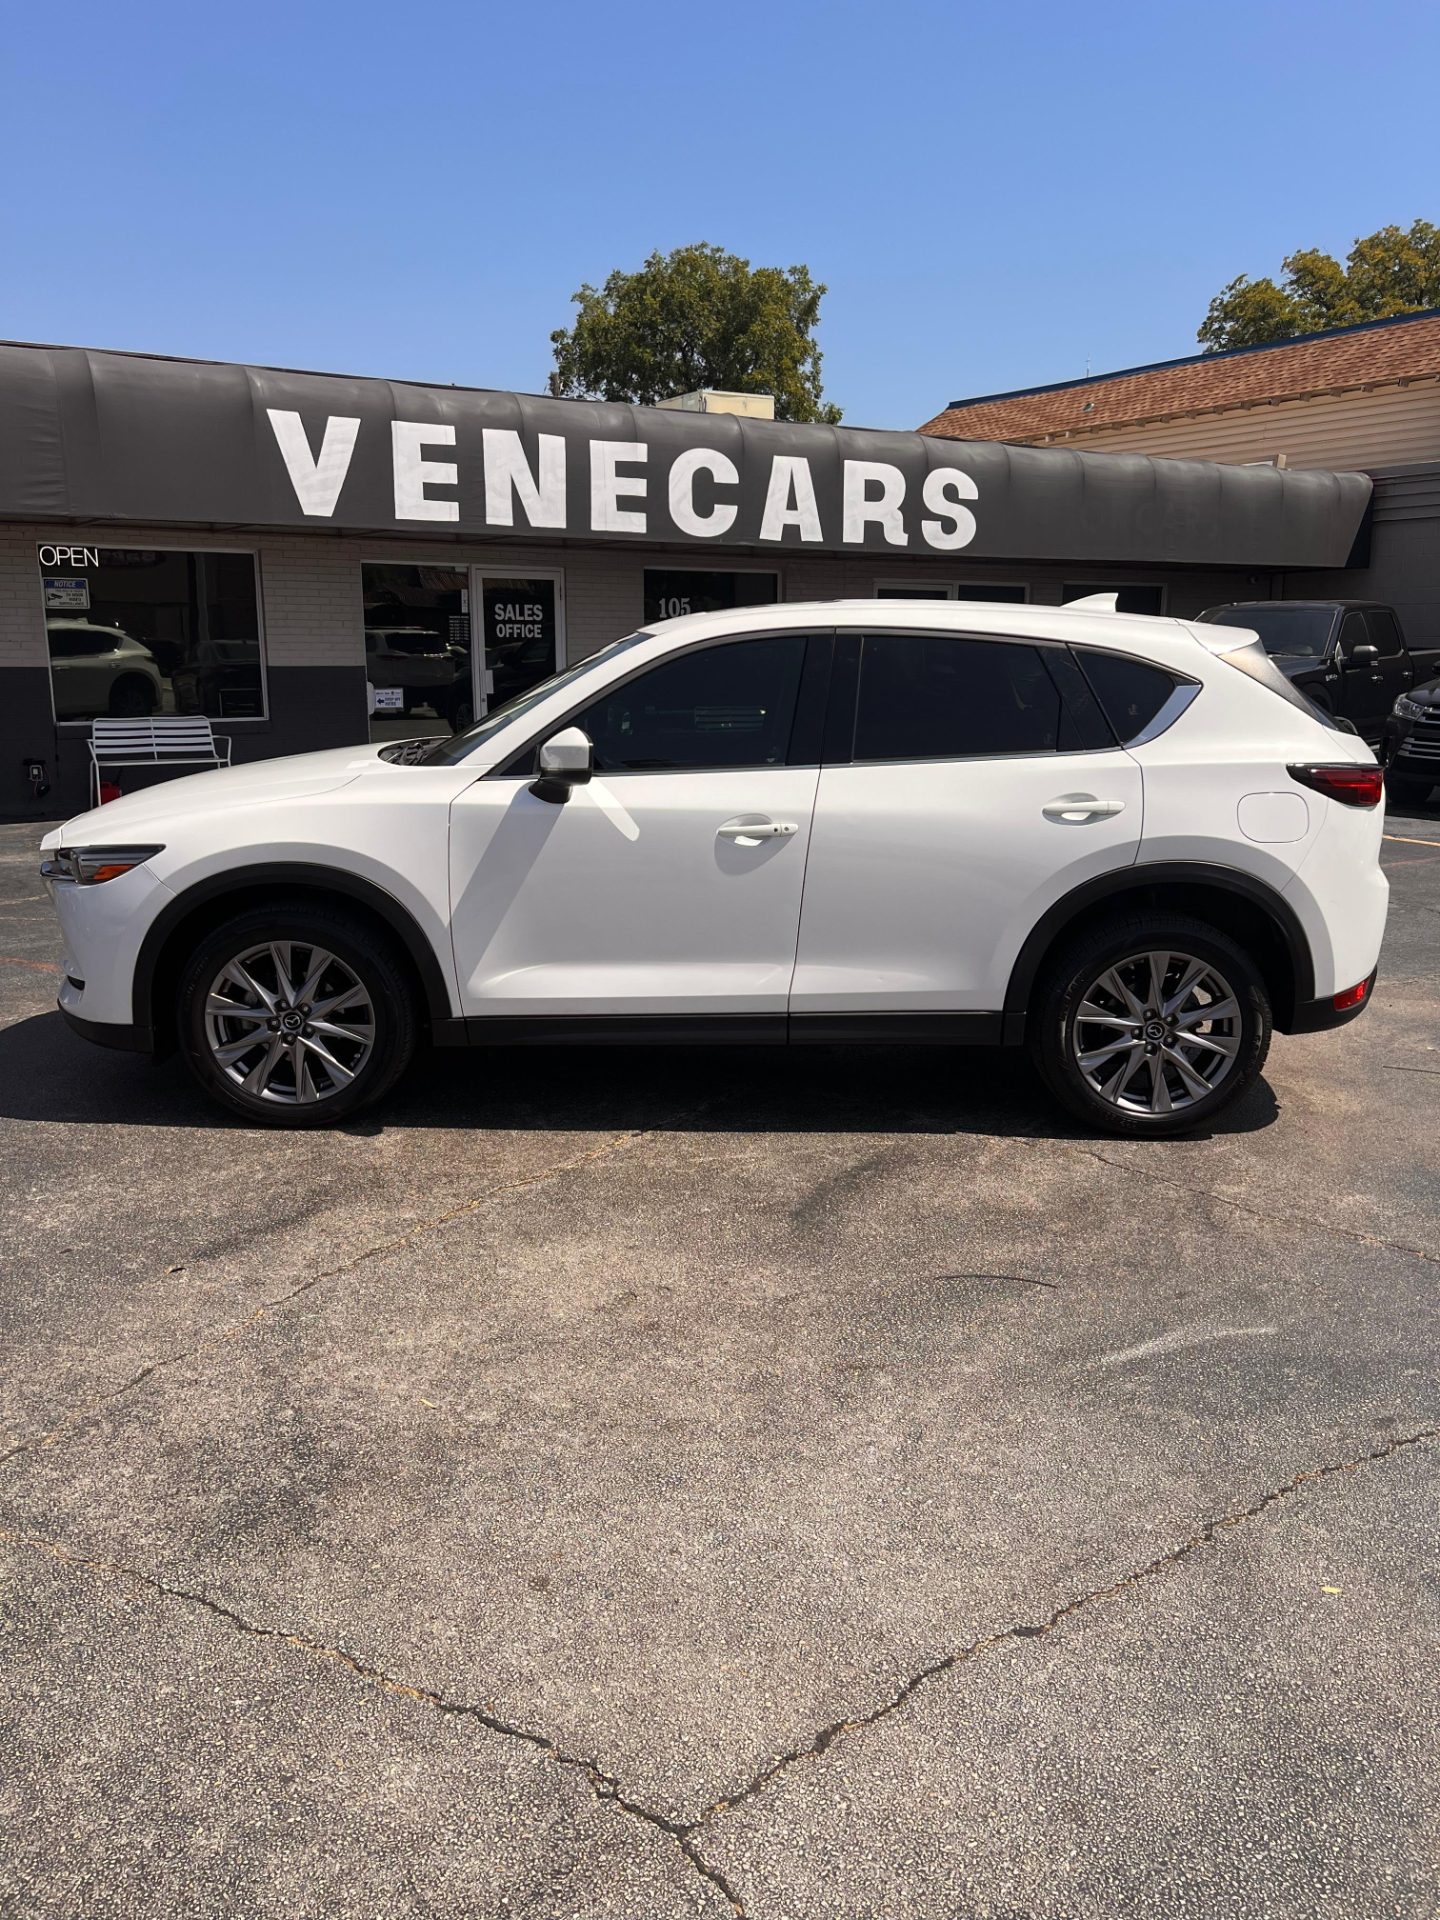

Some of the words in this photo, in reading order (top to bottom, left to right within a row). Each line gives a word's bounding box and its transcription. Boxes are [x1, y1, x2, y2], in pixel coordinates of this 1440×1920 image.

[266, 408, 979, 550] VENECARS
[39, 546, 99, 568] OPEN
[54, 580, 76, 588] NOTICE
[494, 603, 543, 621] SALES
[658, 597, 691, 618] 105
[496, 624, 542, 638] OFFICE
